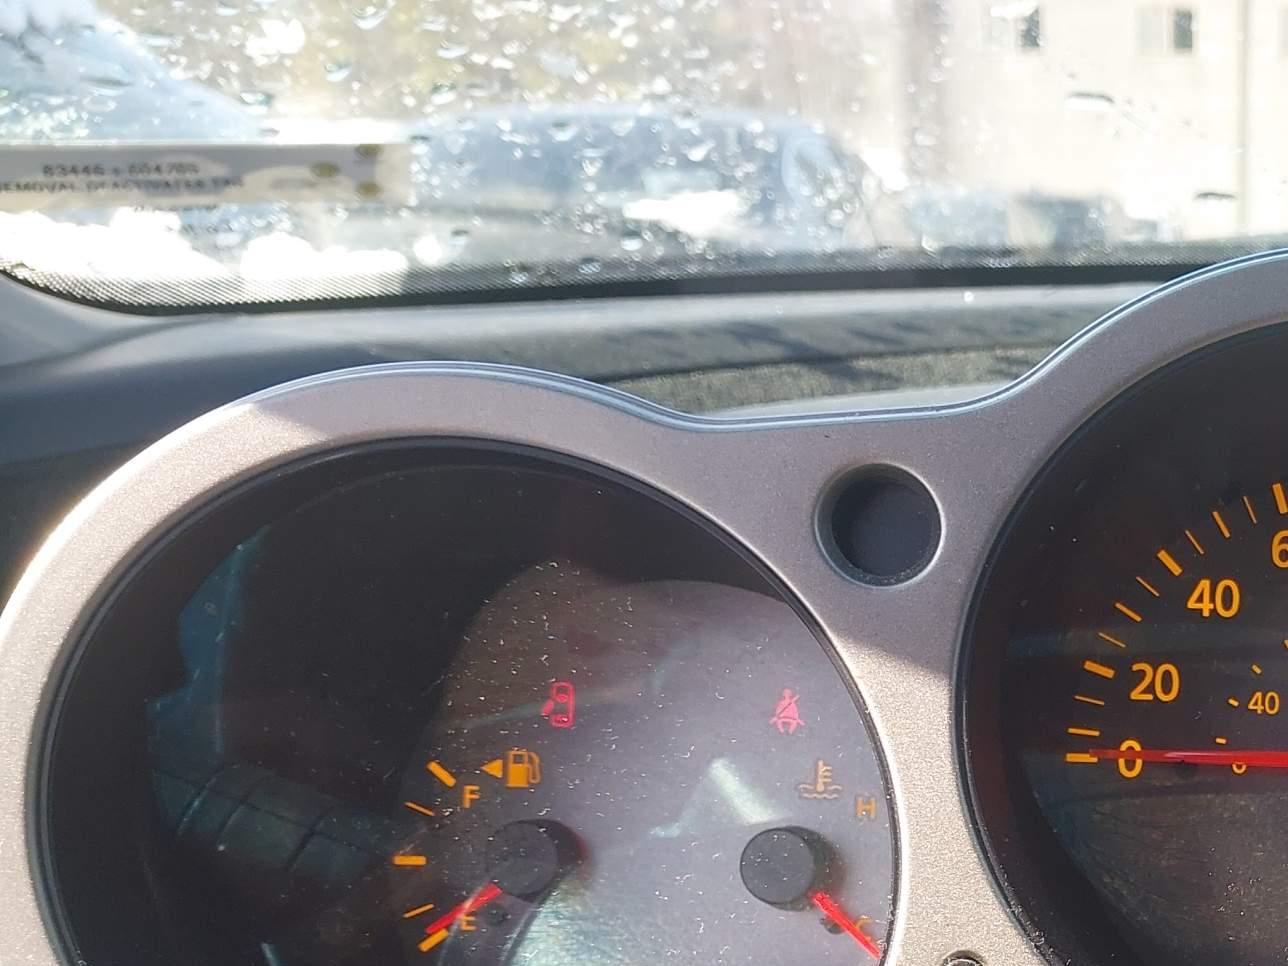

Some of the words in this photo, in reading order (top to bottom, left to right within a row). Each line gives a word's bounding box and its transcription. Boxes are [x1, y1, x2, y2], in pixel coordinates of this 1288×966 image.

[1186, 578, 1241, 618] 40
[1129, 662, 1180, 702] 20
[1247, 691, 1281, 715] 40
[1117, 739, 1143, 778] 0
[461, 784, 481, 809] F
[854, 796, 878, 820] H
[458, 914, 477, 934] E
